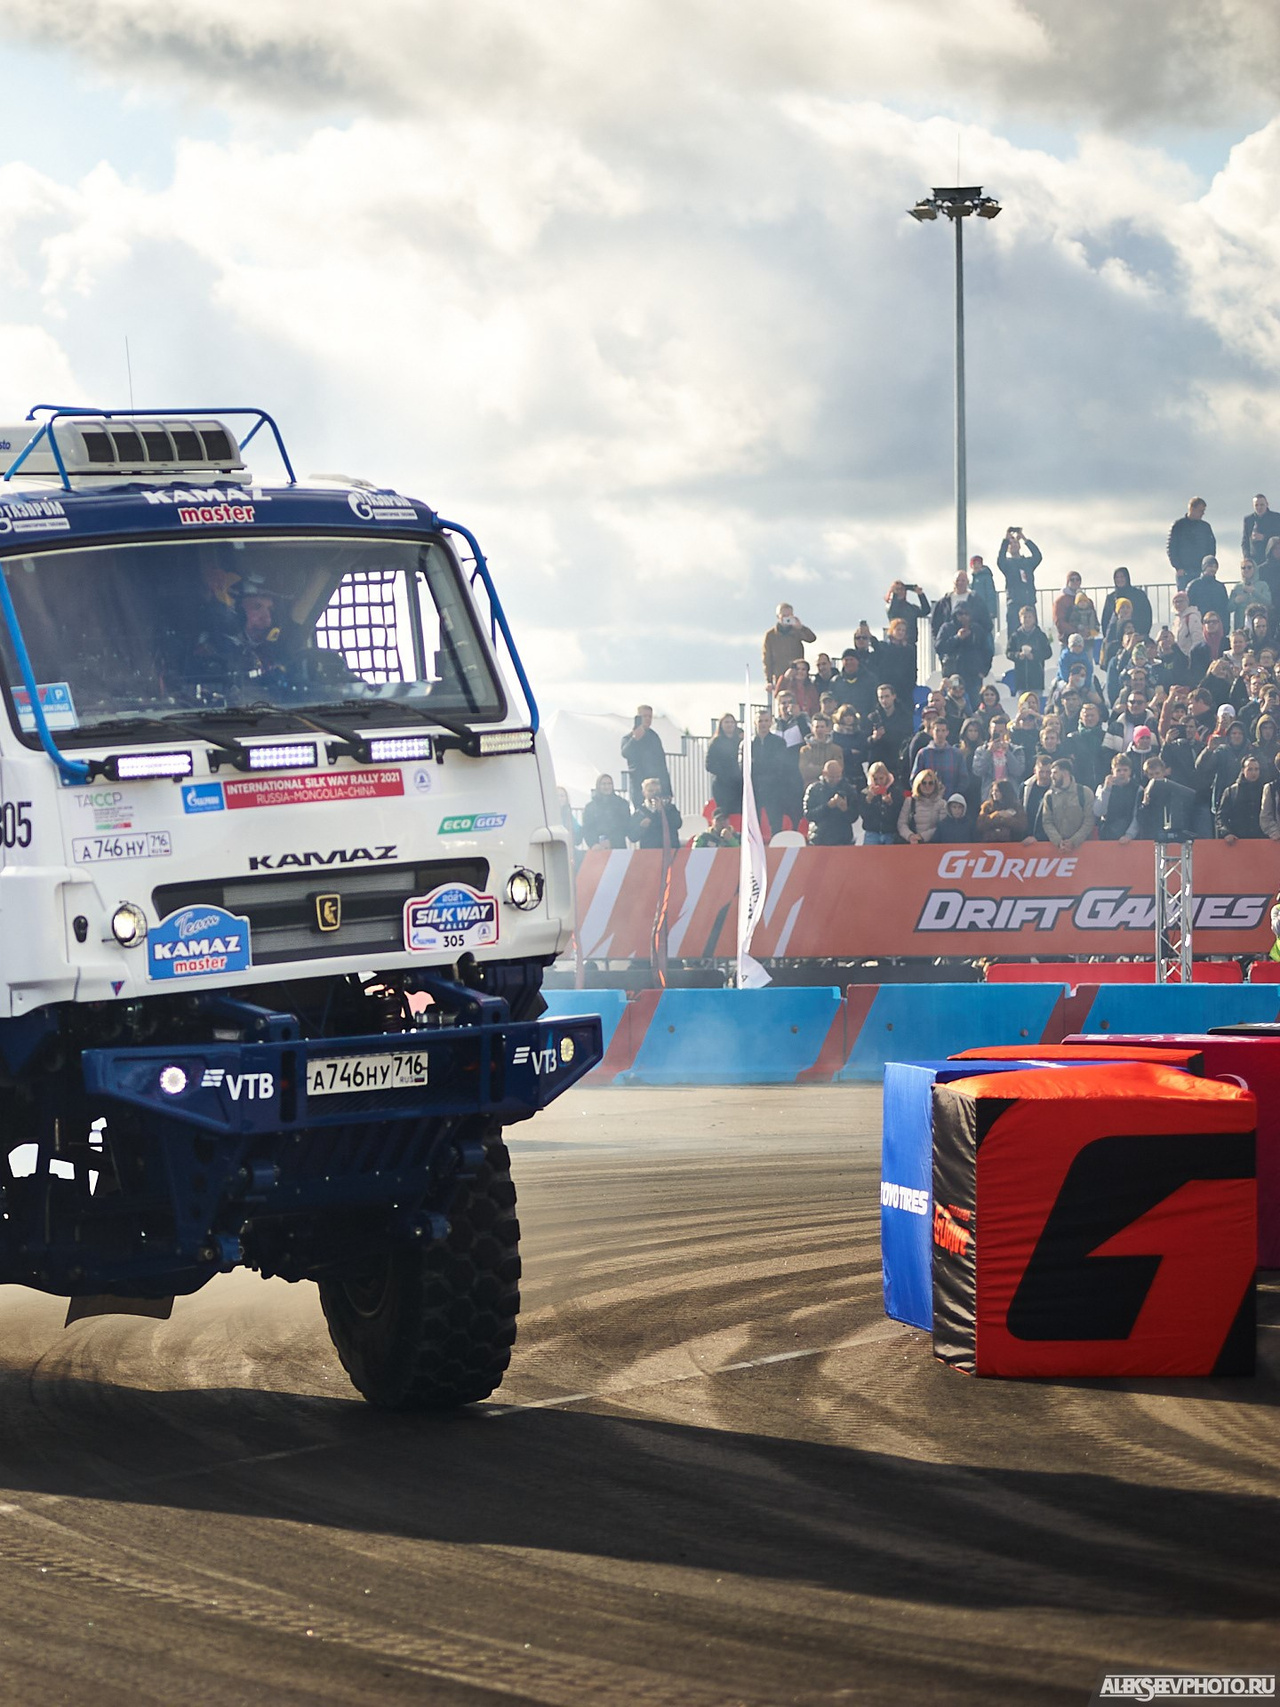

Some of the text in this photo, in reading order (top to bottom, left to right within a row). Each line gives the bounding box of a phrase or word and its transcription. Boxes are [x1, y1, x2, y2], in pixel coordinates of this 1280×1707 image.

[3, 501, 65, 519] ГАЗПРОМ
[180, 503, 255, 524] master
[226, 779, 304, 796] INTERNATIONAL
[304, 776, 326, 788] SILK
[326, 775, 350, 787] WAY
[350, 773, 380, 785] RALLY
[380, 771, 401, 783] 2021
[249, 845, 398, 871] KAMAZ
[415, 905, 491, 925] SILK WAY
[916, 890, 1075, 931] DRIFT
[174, 911, 220, 939] Team
[438, 921, 469, 930] RALLY
[153, 935, 241, 960] KAMAZ
[443, 934, 465, 948] 305
[174, 956, 227, 974] master
[393, 1054, 423, 1077] 716
[225, 1070, 275, 1101] VTB
